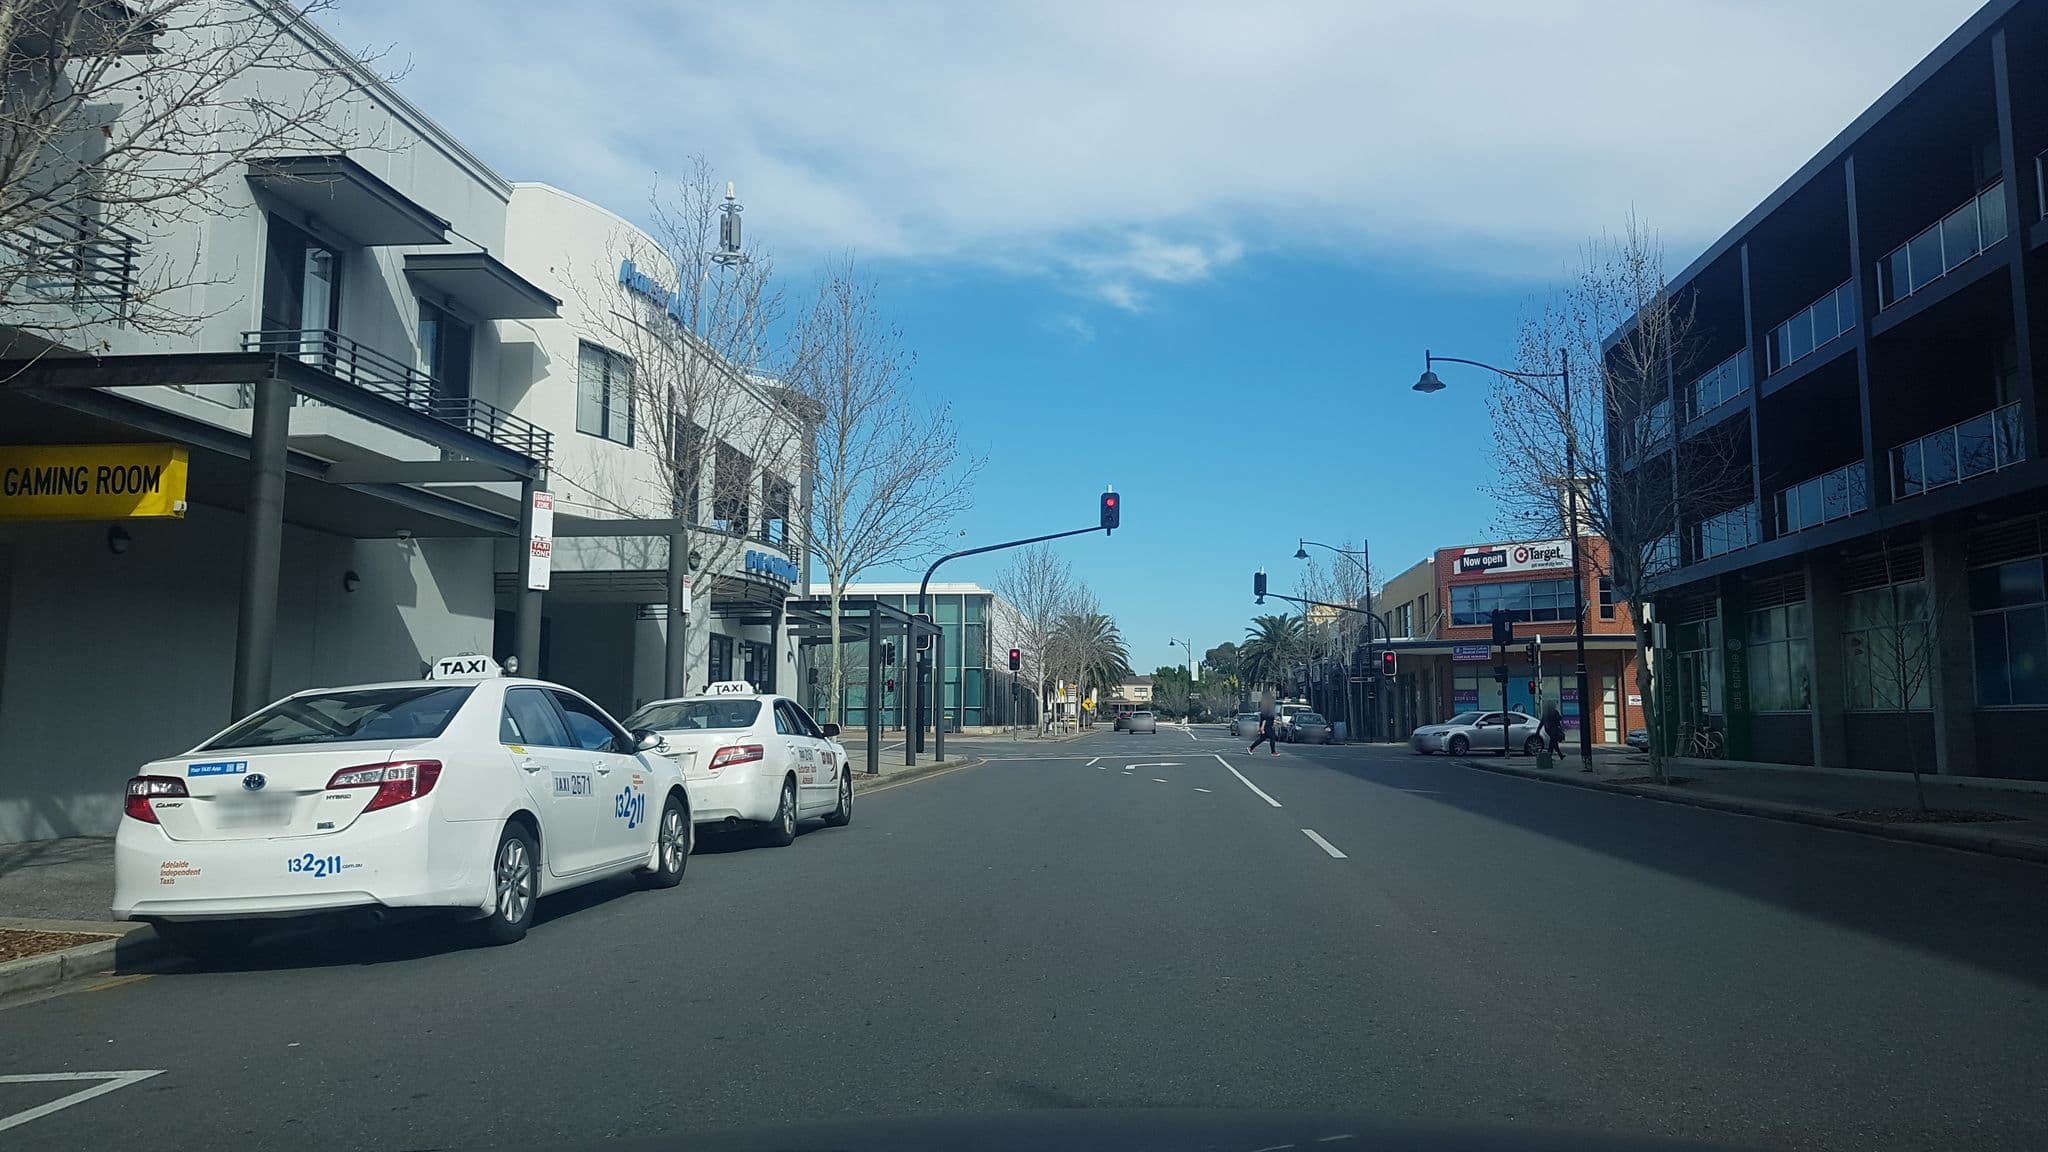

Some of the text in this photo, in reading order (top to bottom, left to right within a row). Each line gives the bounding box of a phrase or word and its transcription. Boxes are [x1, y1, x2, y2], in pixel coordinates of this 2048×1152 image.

[4, 464, 162, 497] GAMING ROOM
[533, 542, 550, 550] TAXI
[1463, 554, 1503, 567] Now open
[440, 660, 486, 675] TAXI
[714, 684, 743, 695] TAXI
[555, 777, 570, 792] TAXI
[161, 860, 190, 868] Adelaide
[160, 868, 201, 877] Independent
[160, 877, 175, 885] Taxis
